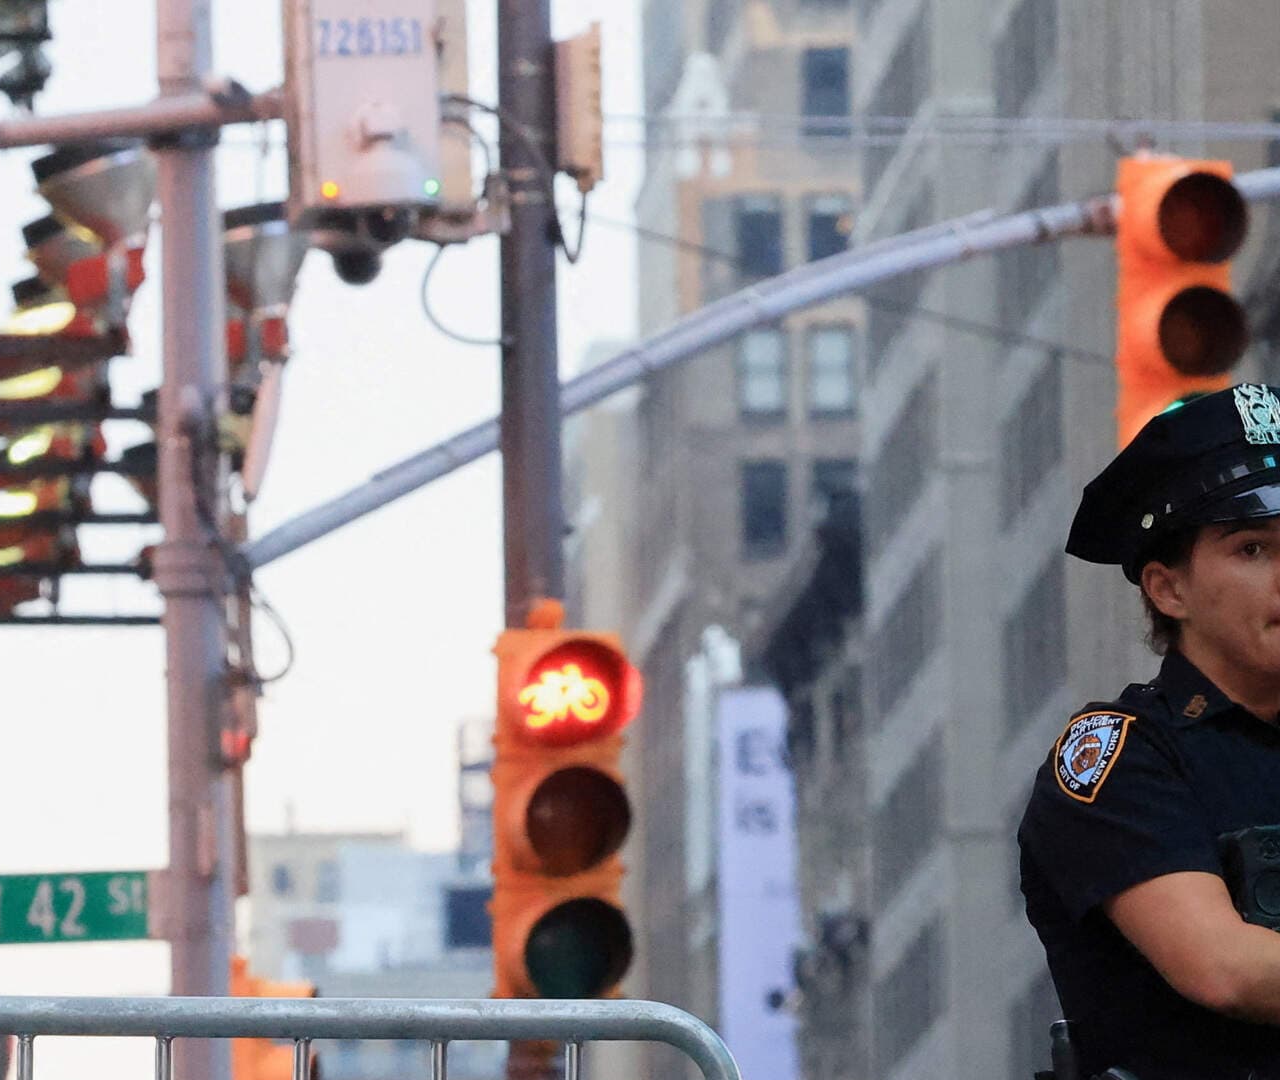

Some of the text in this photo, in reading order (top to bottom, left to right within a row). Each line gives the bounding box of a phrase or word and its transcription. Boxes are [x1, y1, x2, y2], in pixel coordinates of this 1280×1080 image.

[1091, 728, 1121, 783] NEW YORK
[27, 878, 86, 937] 42
